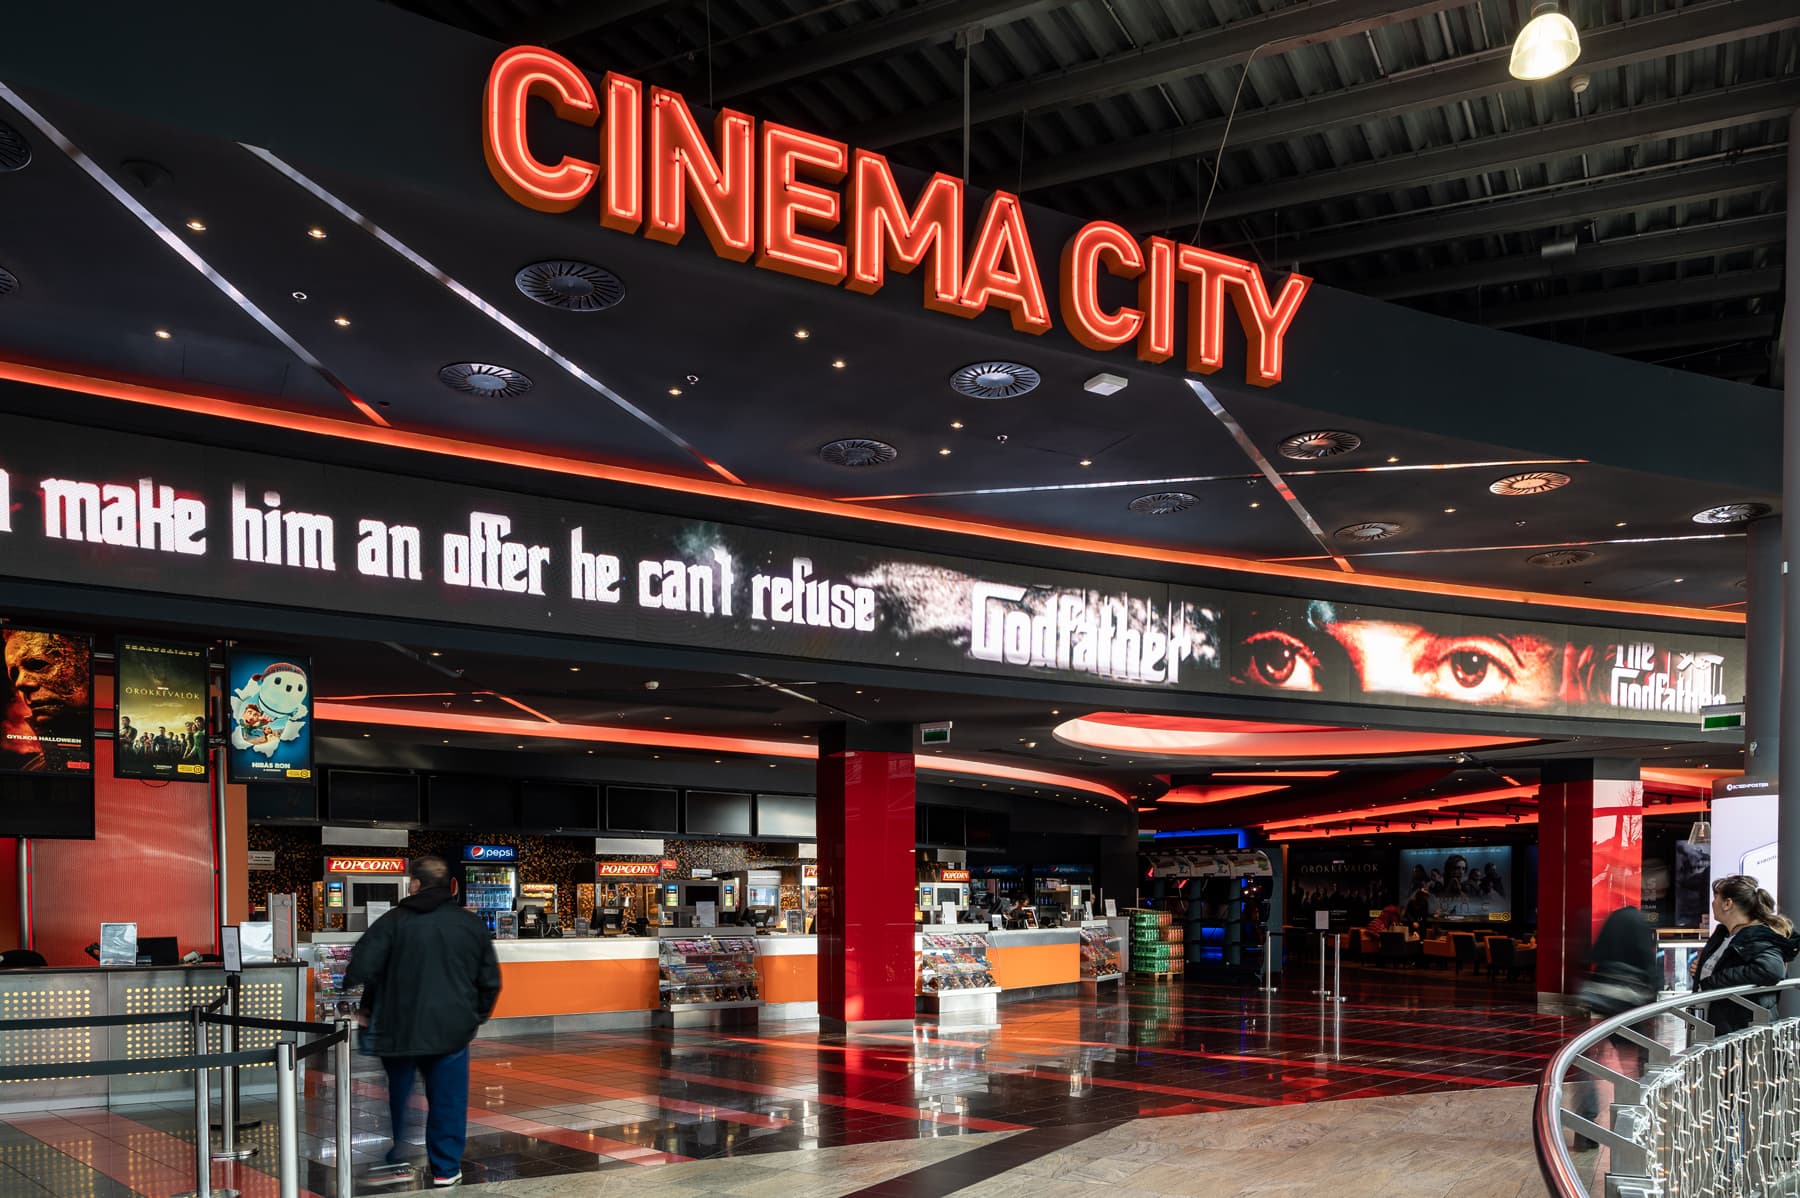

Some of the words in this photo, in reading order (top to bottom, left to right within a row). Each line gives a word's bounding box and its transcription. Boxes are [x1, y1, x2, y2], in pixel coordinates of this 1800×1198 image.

[482, 45, 1052, 335] CINEMA
[1060, 221, 1313, 388] CITY
[40, 477, 206, 555] make
[232, 481, 336, 571] him
[358, 519, 422, 580] an
[443, 511, 550, 596] offer
[571, 526, 620, 603] he
[752, 557, 875, 632] refuse
[971, 581, 1192, 685] Godfather
[38, 736, 82, 744] HALLOWEEN
[486, 848, 513, 858] pepsi
[331, 860, 402, 870] POPCORN
[601, 865, 657, 874] POPCORN
[943, 871, 969, 881] POPCORN
